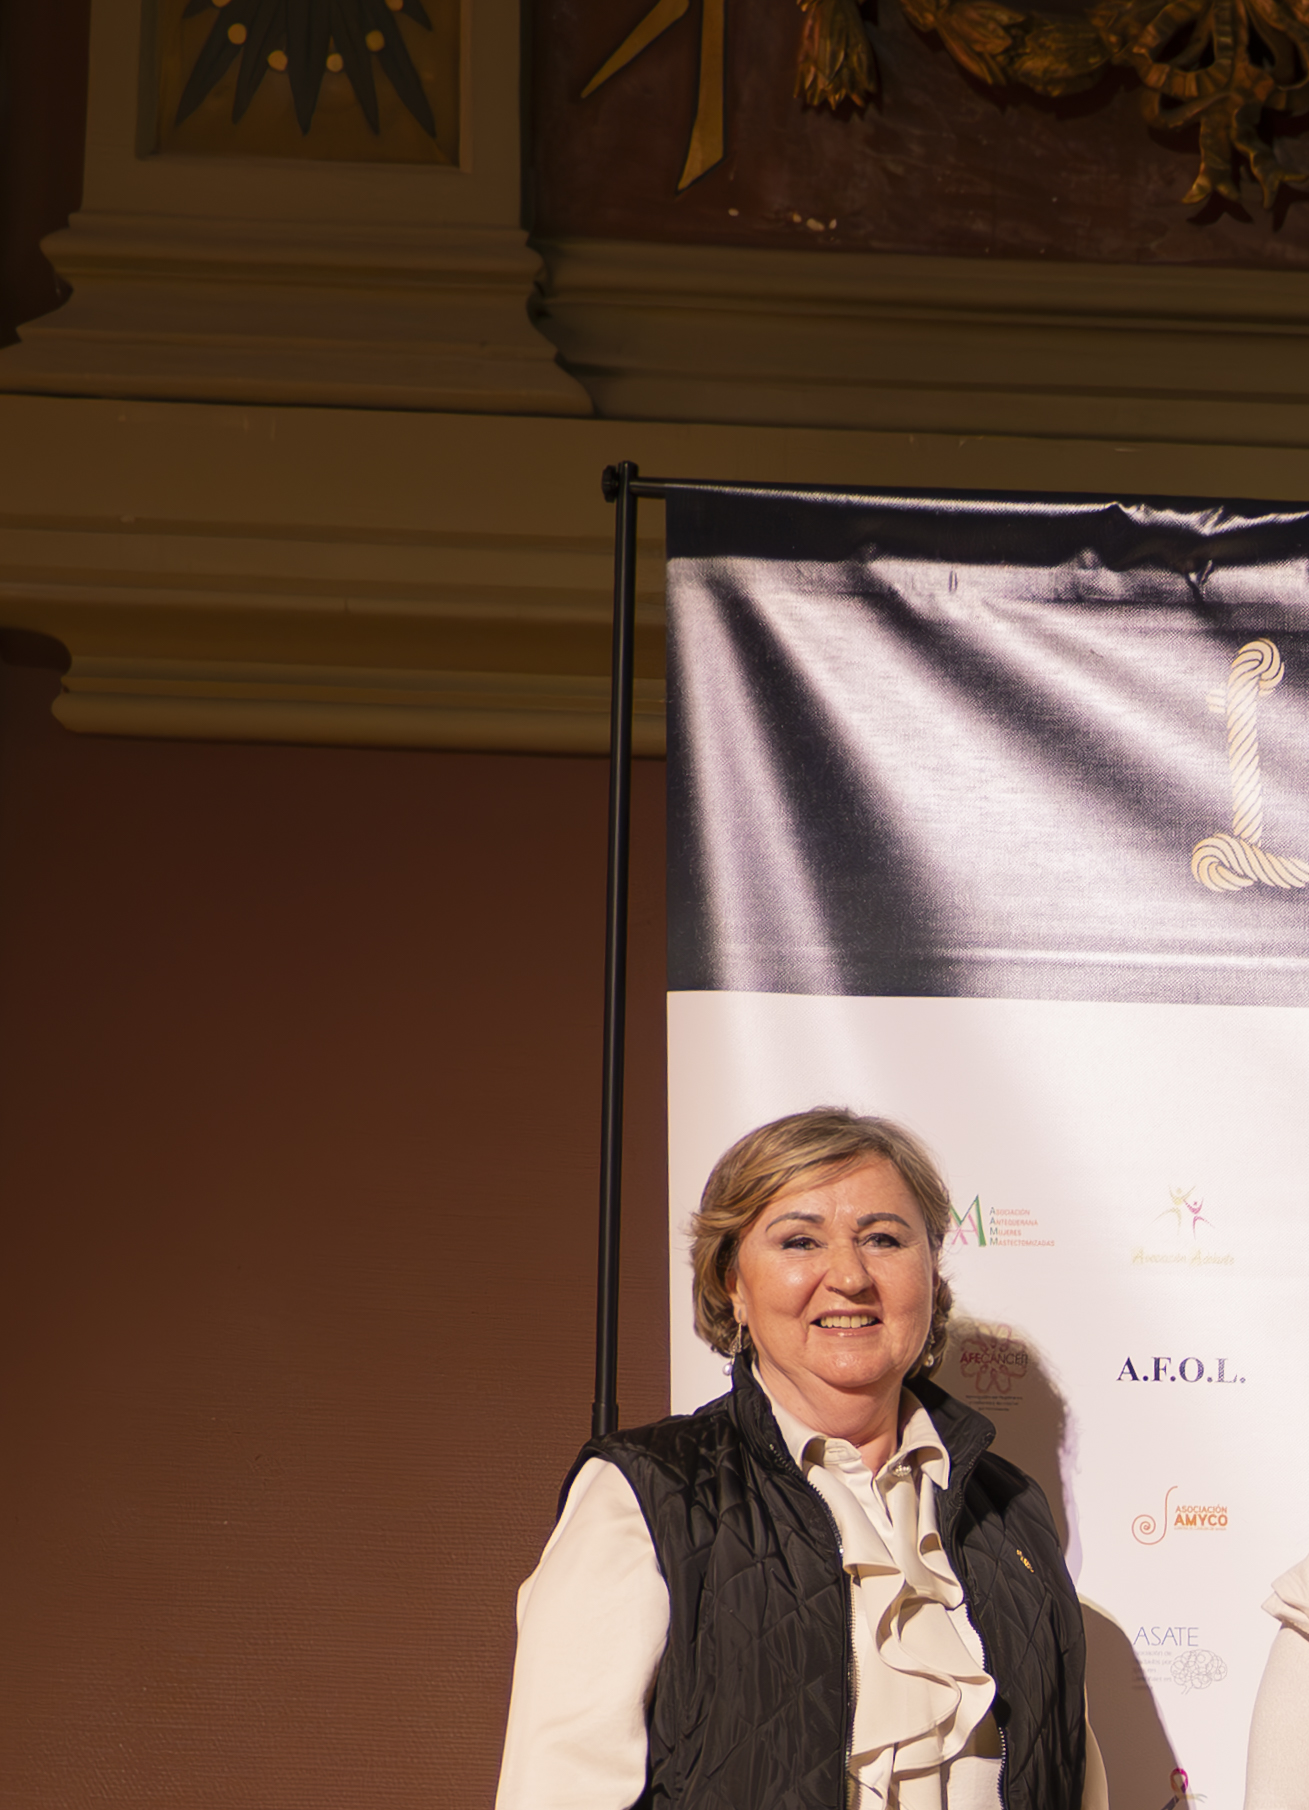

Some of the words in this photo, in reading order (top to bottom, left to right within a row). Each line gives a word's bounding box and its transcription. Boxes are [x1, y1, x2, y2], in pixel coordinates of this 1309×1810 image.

[1115, 1355, 1247, 1384] A.F.O.L.
[1175, 1504, 1229, 1514] ASOCIACIÓN
[1173, 1513, 1229, 1527] AMYCO
[1132, 1626, 1200, 1647] ASATE
